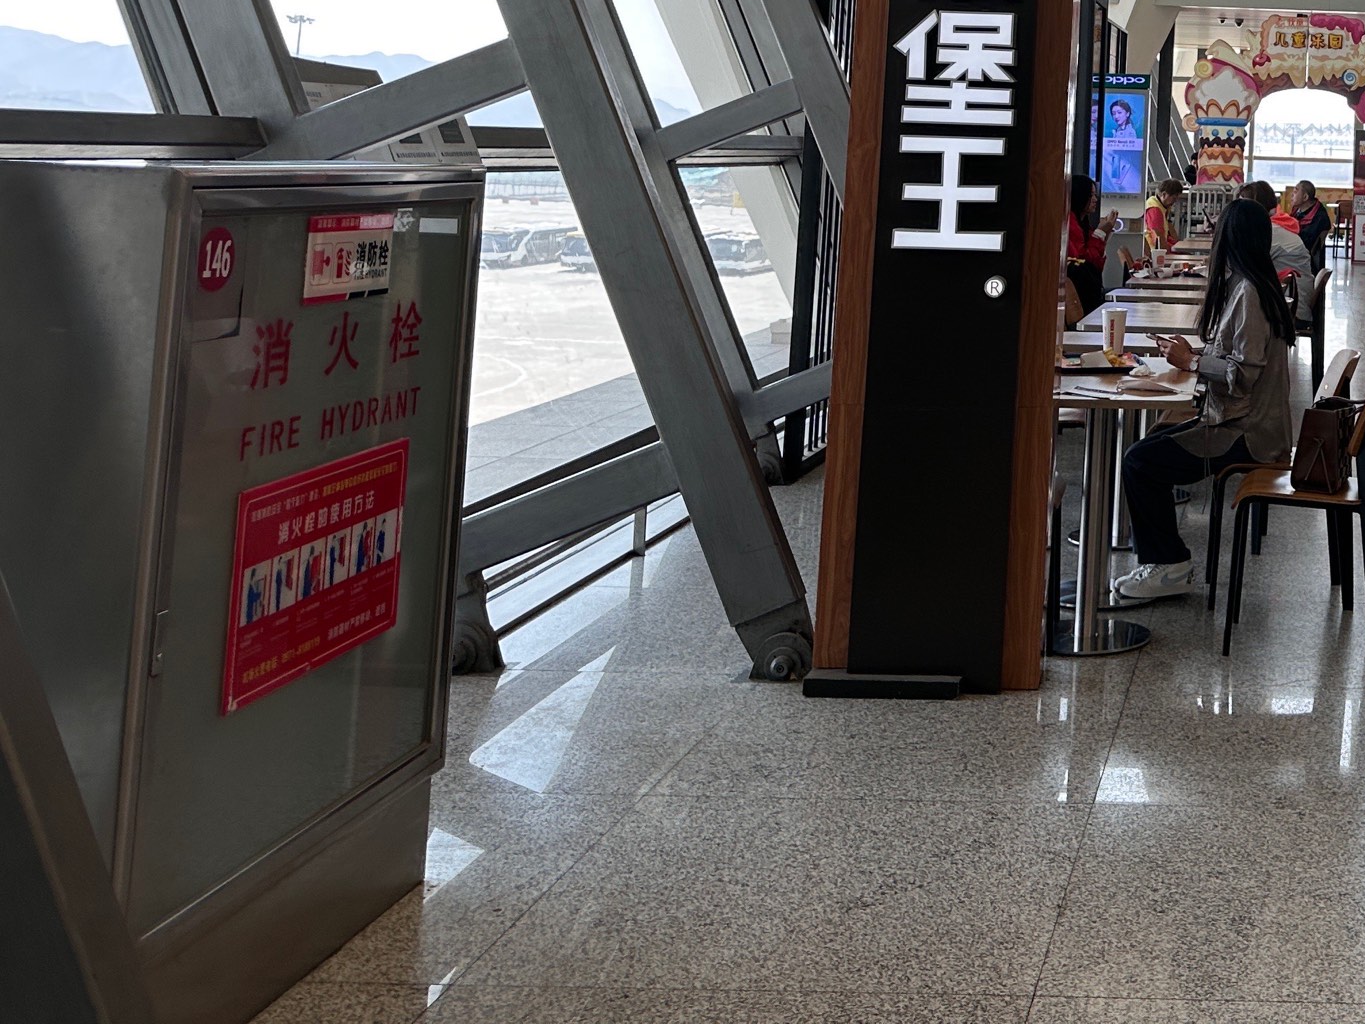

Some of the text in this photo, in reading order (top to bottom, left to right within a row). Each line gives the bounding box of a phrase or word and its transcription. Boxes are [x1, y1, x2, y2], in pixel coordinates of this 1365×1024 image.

[1274, 31, 1343, 49] 儿童乐园
[203, 239, 232, 278] 146
[250, 301, 423, 391] 消火栓
[239, 387, 421, 462] FIRE HYDRANT
[277, 490, 376, 545] 消火栓的使用方法
